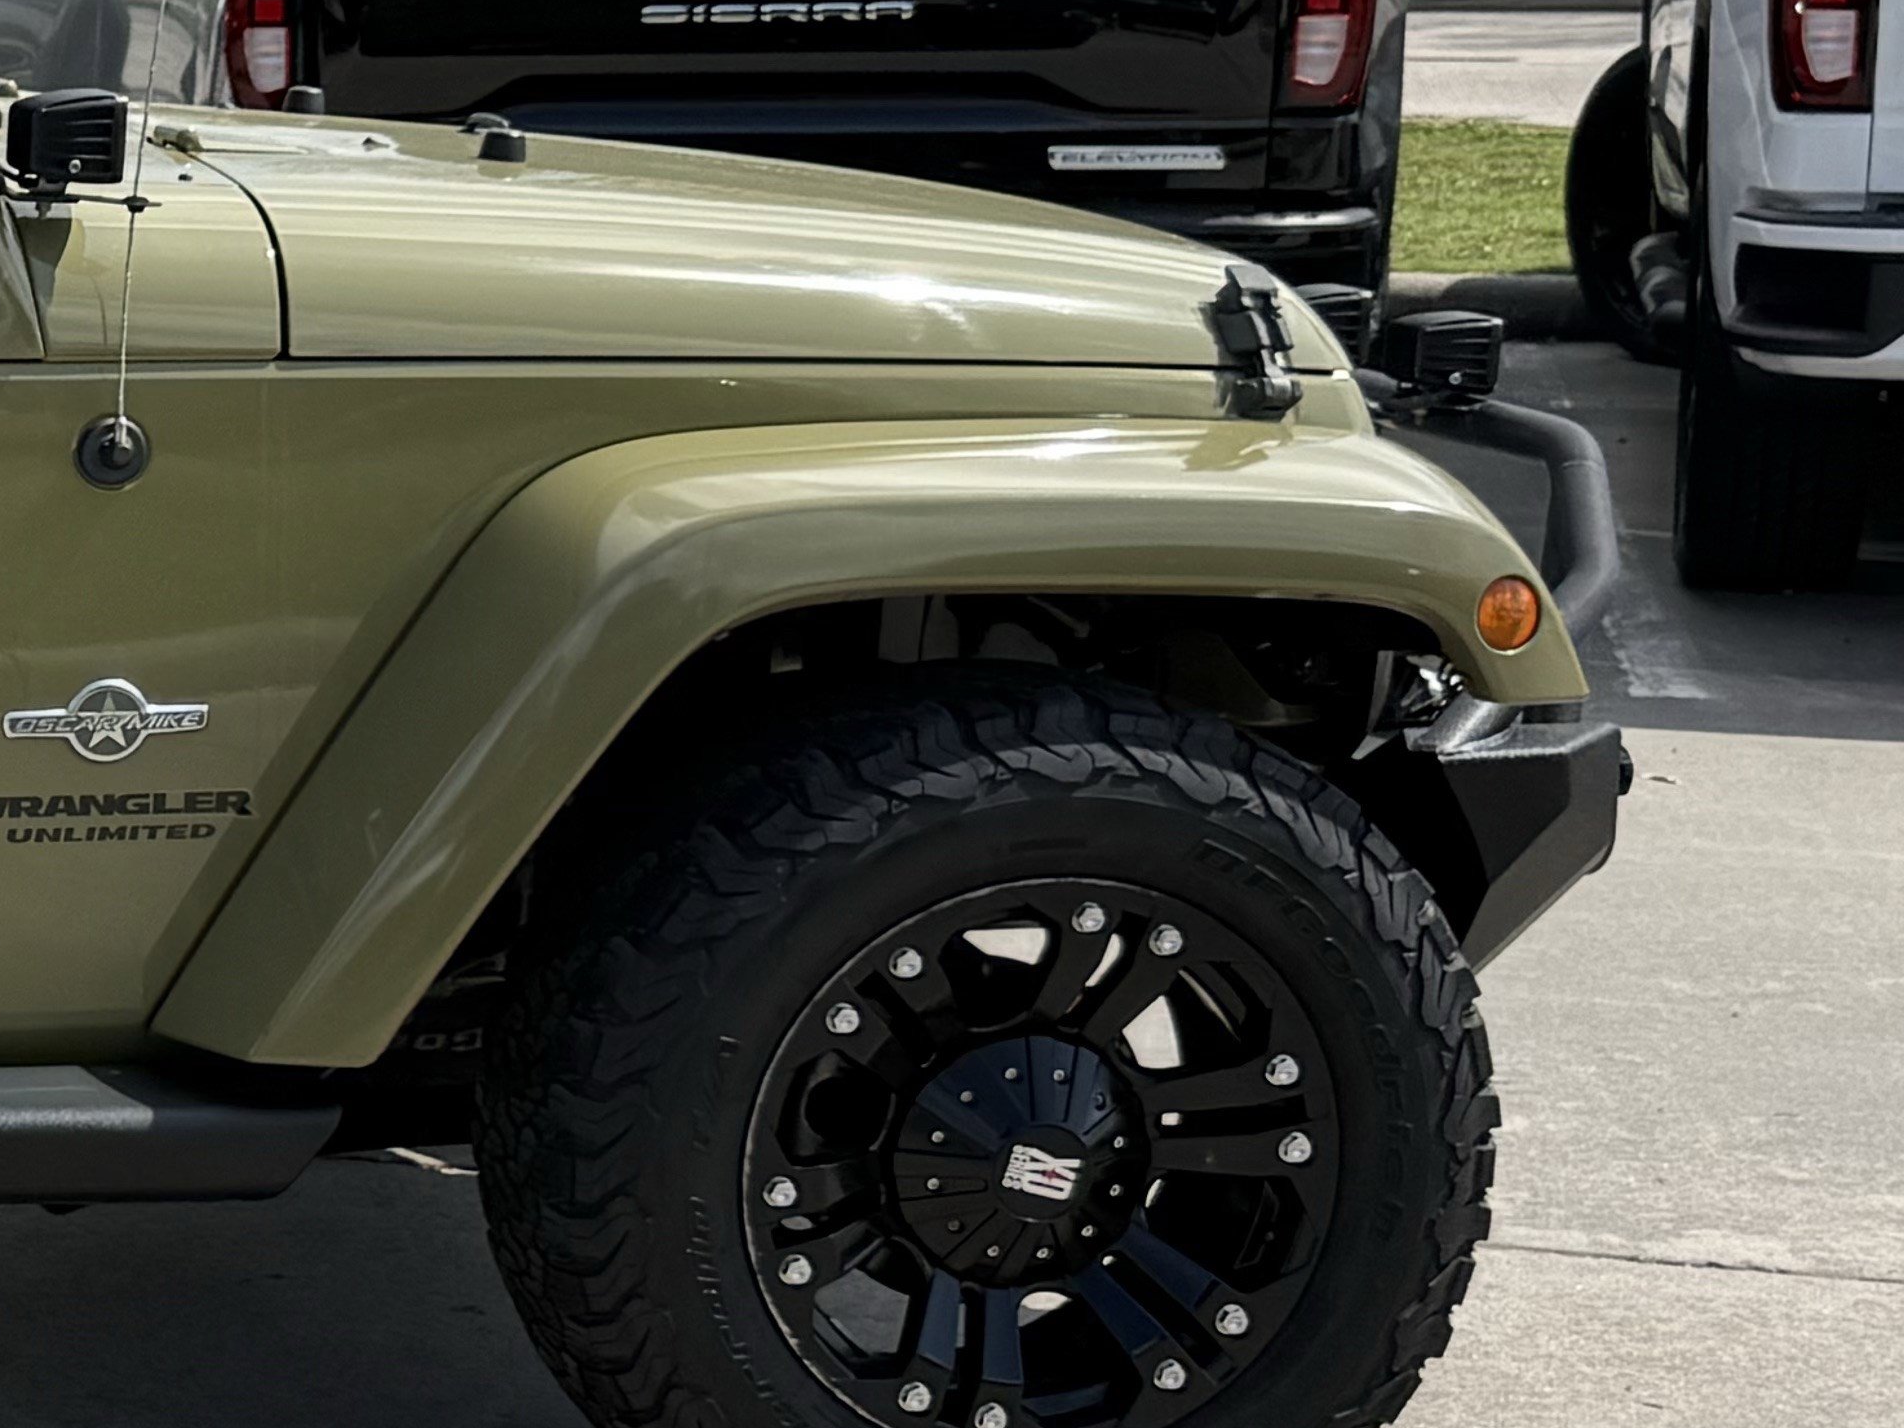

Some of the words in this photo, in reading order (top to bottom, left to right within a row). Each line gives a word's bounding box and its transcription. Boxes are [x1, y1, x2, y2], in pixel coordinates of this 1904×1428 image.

[640, 0, 917, 24] SIERRA
[1060, 151, 1219, 164] ELEVATION
[14, 712, 121, 734] OSCAR
[125, 708, 202, 731] MIKE
[6, 823, 216, 844] UNLIMITED
[1023, 1146, 1081, 1200] XD
